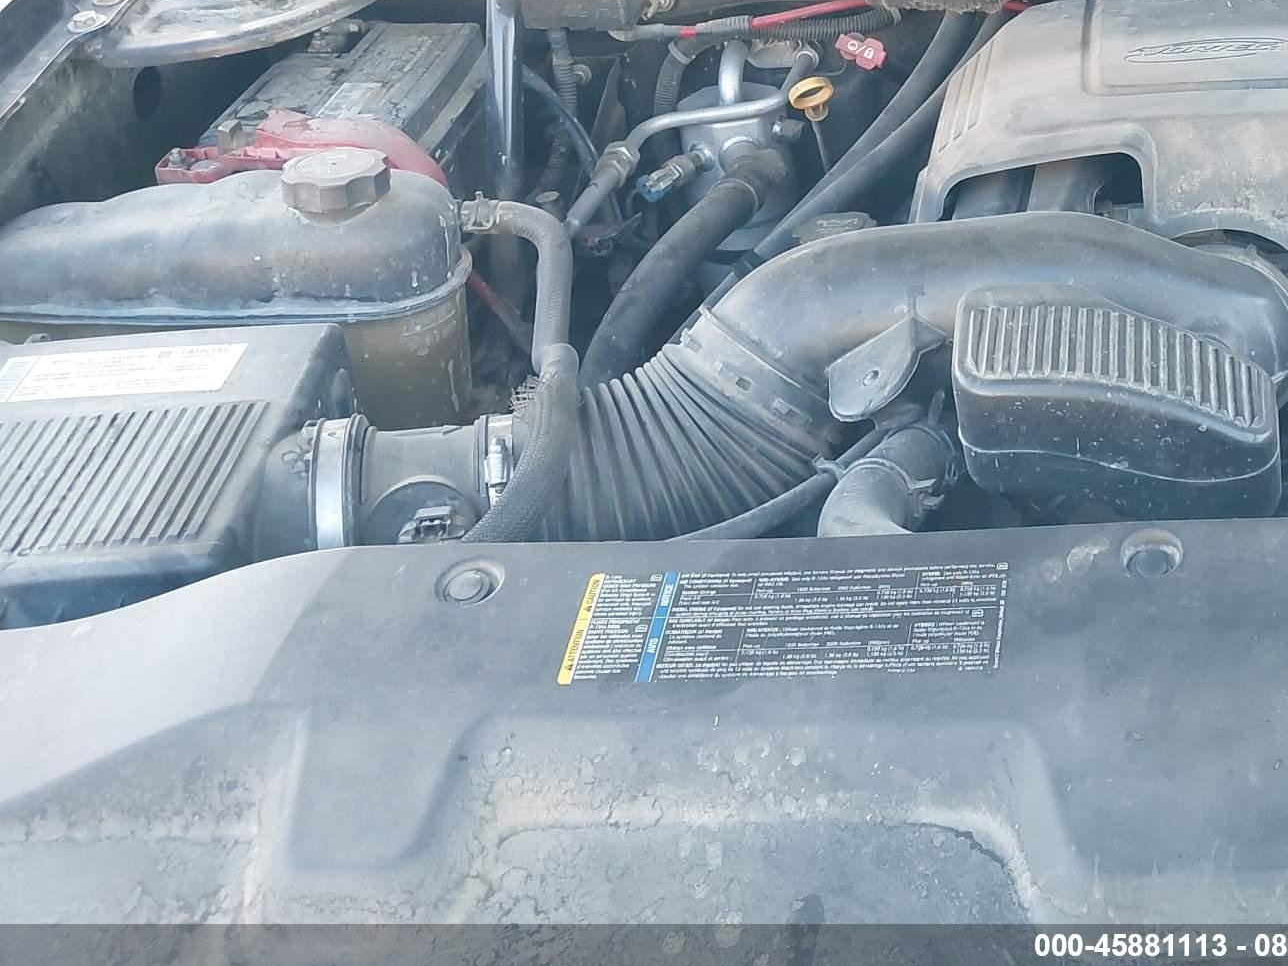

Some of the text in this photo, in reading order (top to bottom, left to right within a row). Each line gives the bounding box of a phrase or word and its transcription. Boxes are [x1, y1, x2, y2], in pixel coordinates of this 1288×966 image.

[585, 579, 601, 605] CAUTION
[660, 583, 674, 607] NOTICE
[567, 629, 585, 662] ATTENTION
[647, 637, 659, 654] AVIS
